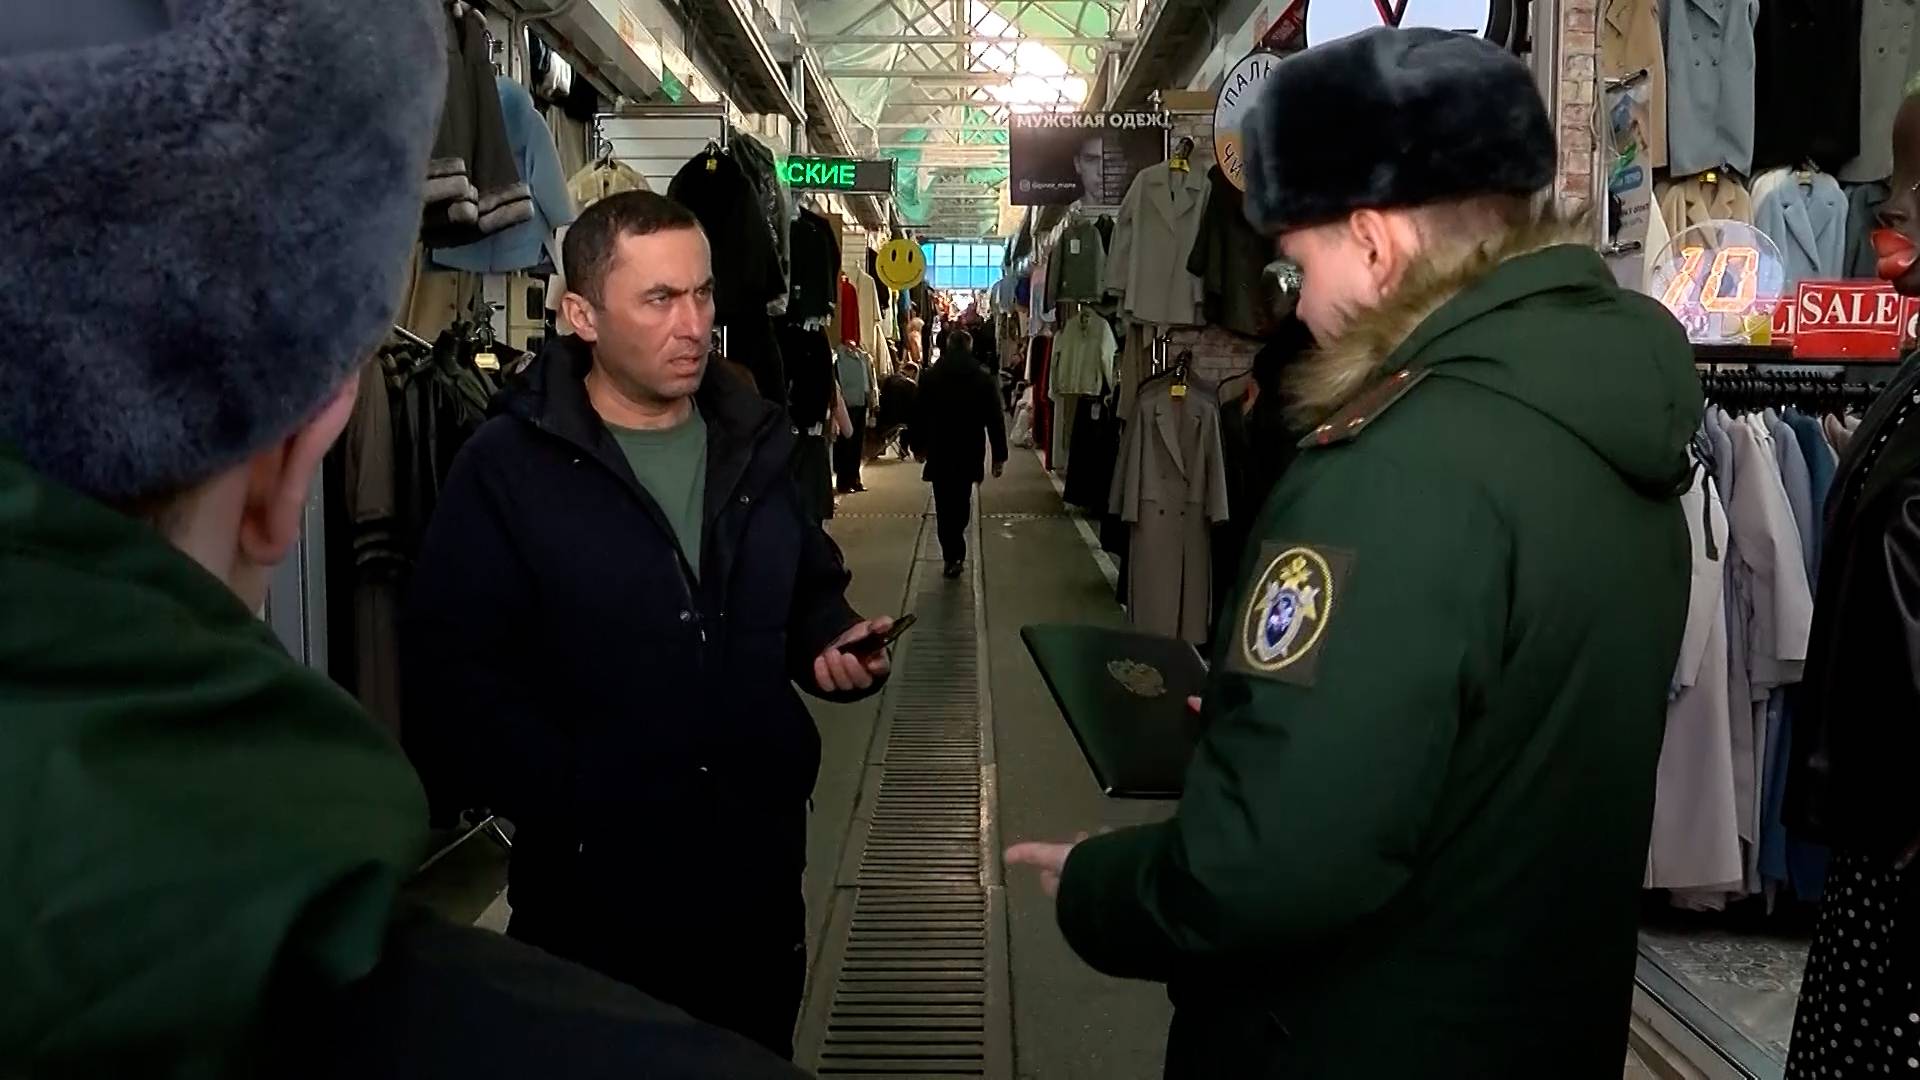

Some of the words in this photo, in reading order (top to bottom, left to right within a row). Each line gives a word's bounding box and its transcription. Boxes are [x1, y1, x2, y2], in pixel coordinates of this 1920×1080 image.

[1017, 113, 1105, 128] МУЖСКАЯ
[776, 161, 856, 186] СКИЕ
[1801, 291, 1899, 325] SALE
